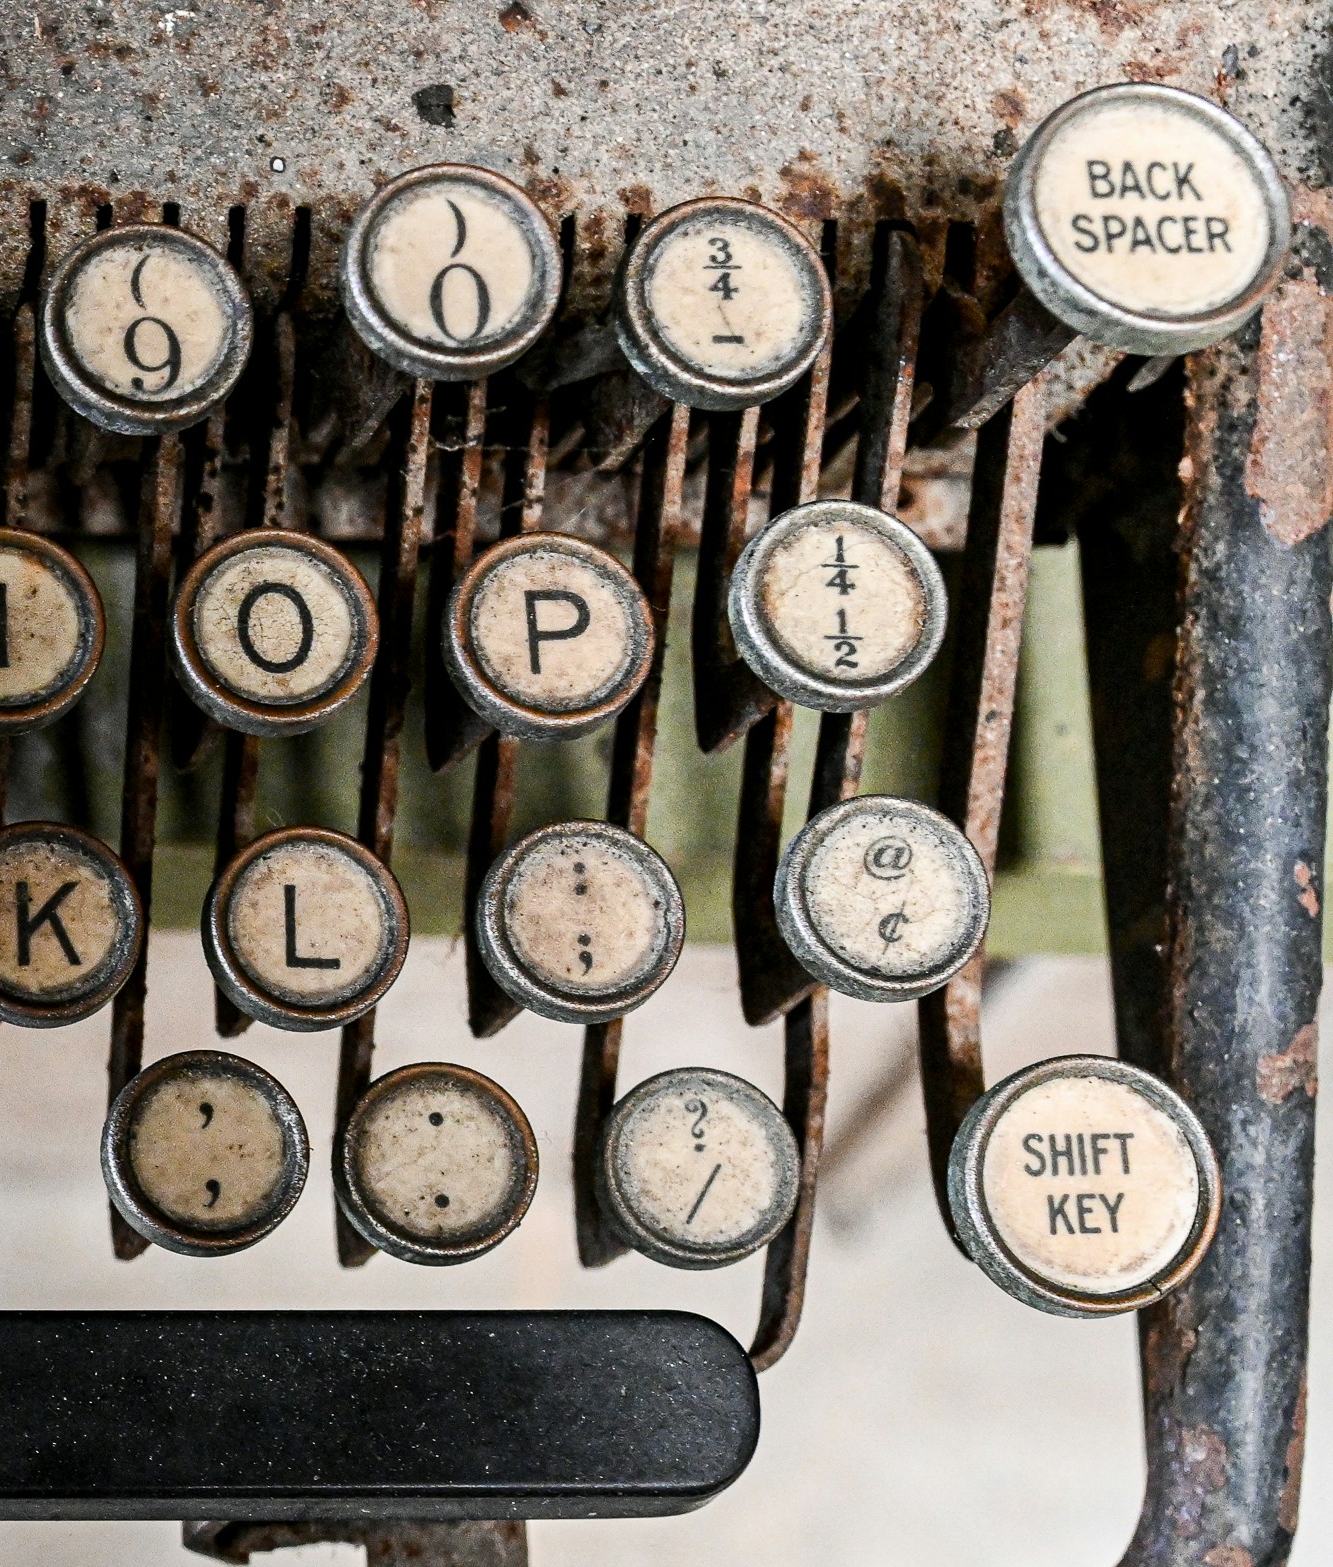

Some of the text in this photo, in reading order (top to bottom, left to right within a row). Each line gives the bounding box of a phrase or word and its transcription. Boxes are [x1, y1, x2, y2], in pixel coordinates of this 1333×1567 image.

[1086, 160, 1203, 202] BACK
[446, 199, 467, 259] )
[1071, 214, 1233, 254] SPACER
[130, 254, 151, 311] (
[123, 316, 183, 391] 9
[227, 579, 315, 675] O
[523, 587, 591, 676] P
[862, 835, 914, 882] @
[17, 880, 83, 967] K
[283, 883, 340, 970] L
[683, 1097, 709, 1155] ?
[1021, 1132, 1134, 1177] SHIFT
[1046, 1192, 1125, 1236] KEY
